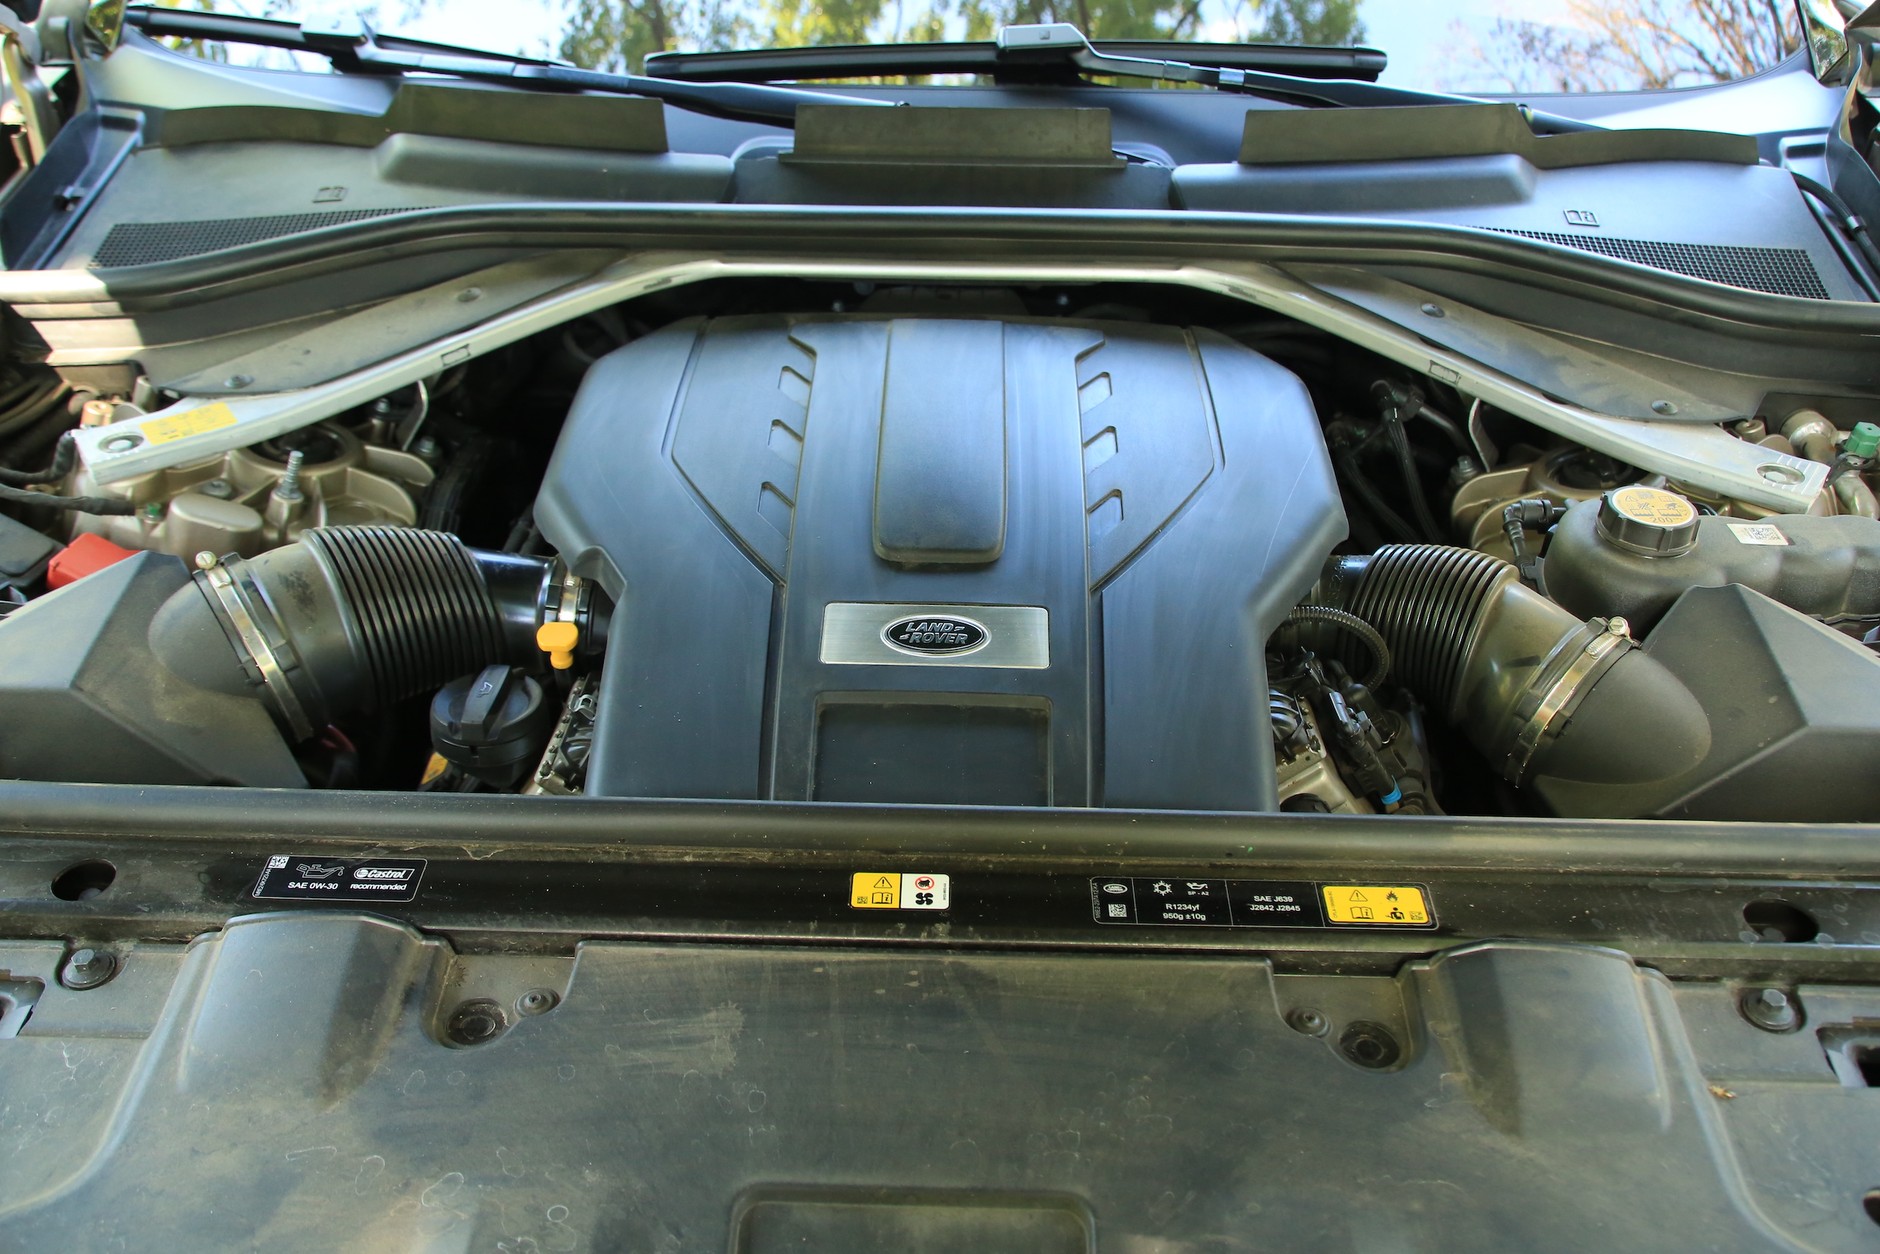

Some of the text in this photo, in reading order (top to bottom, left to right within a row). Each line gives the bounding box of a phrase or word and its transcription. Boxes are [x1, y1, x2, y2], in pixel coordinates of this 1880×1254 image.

[905, 622, 954, 632] LAND
[909, 632, 968, 644] ROVER
[367, 869, 406, 878] Castrol
[287, 881, 339, 890] SAE 0W-30
[350, 883, 408, 891] recommended
[1165, 903, 1200, 911] R1234yf
[1162, 912, 1206, 921] 950g ±10g
